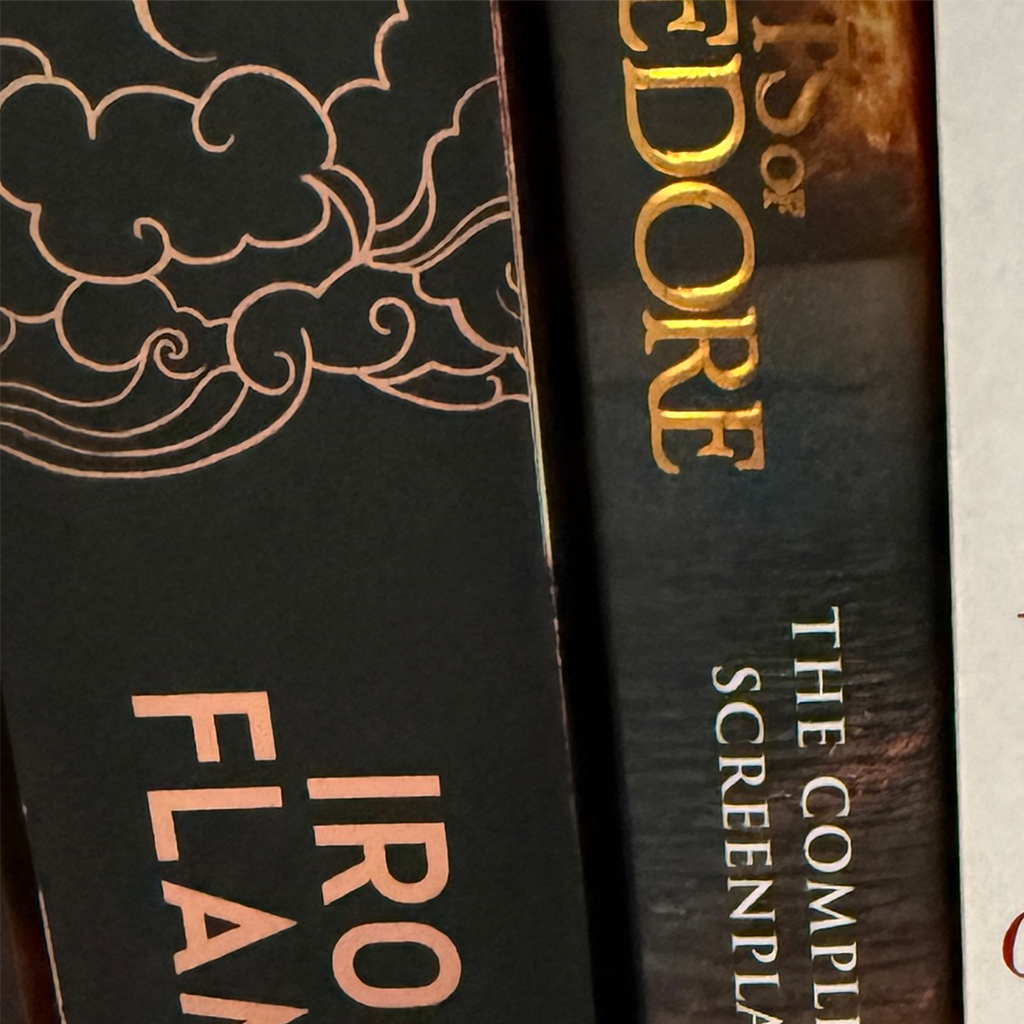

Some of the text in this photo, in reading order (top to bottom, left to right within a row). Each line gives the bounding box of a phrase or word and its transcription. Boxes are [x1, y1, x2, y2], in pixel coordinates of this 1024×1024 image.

[618, 0, 767, 475] EDORE
[760, 143, 806, 218] OF
[790, 605, 847, 749] THE
